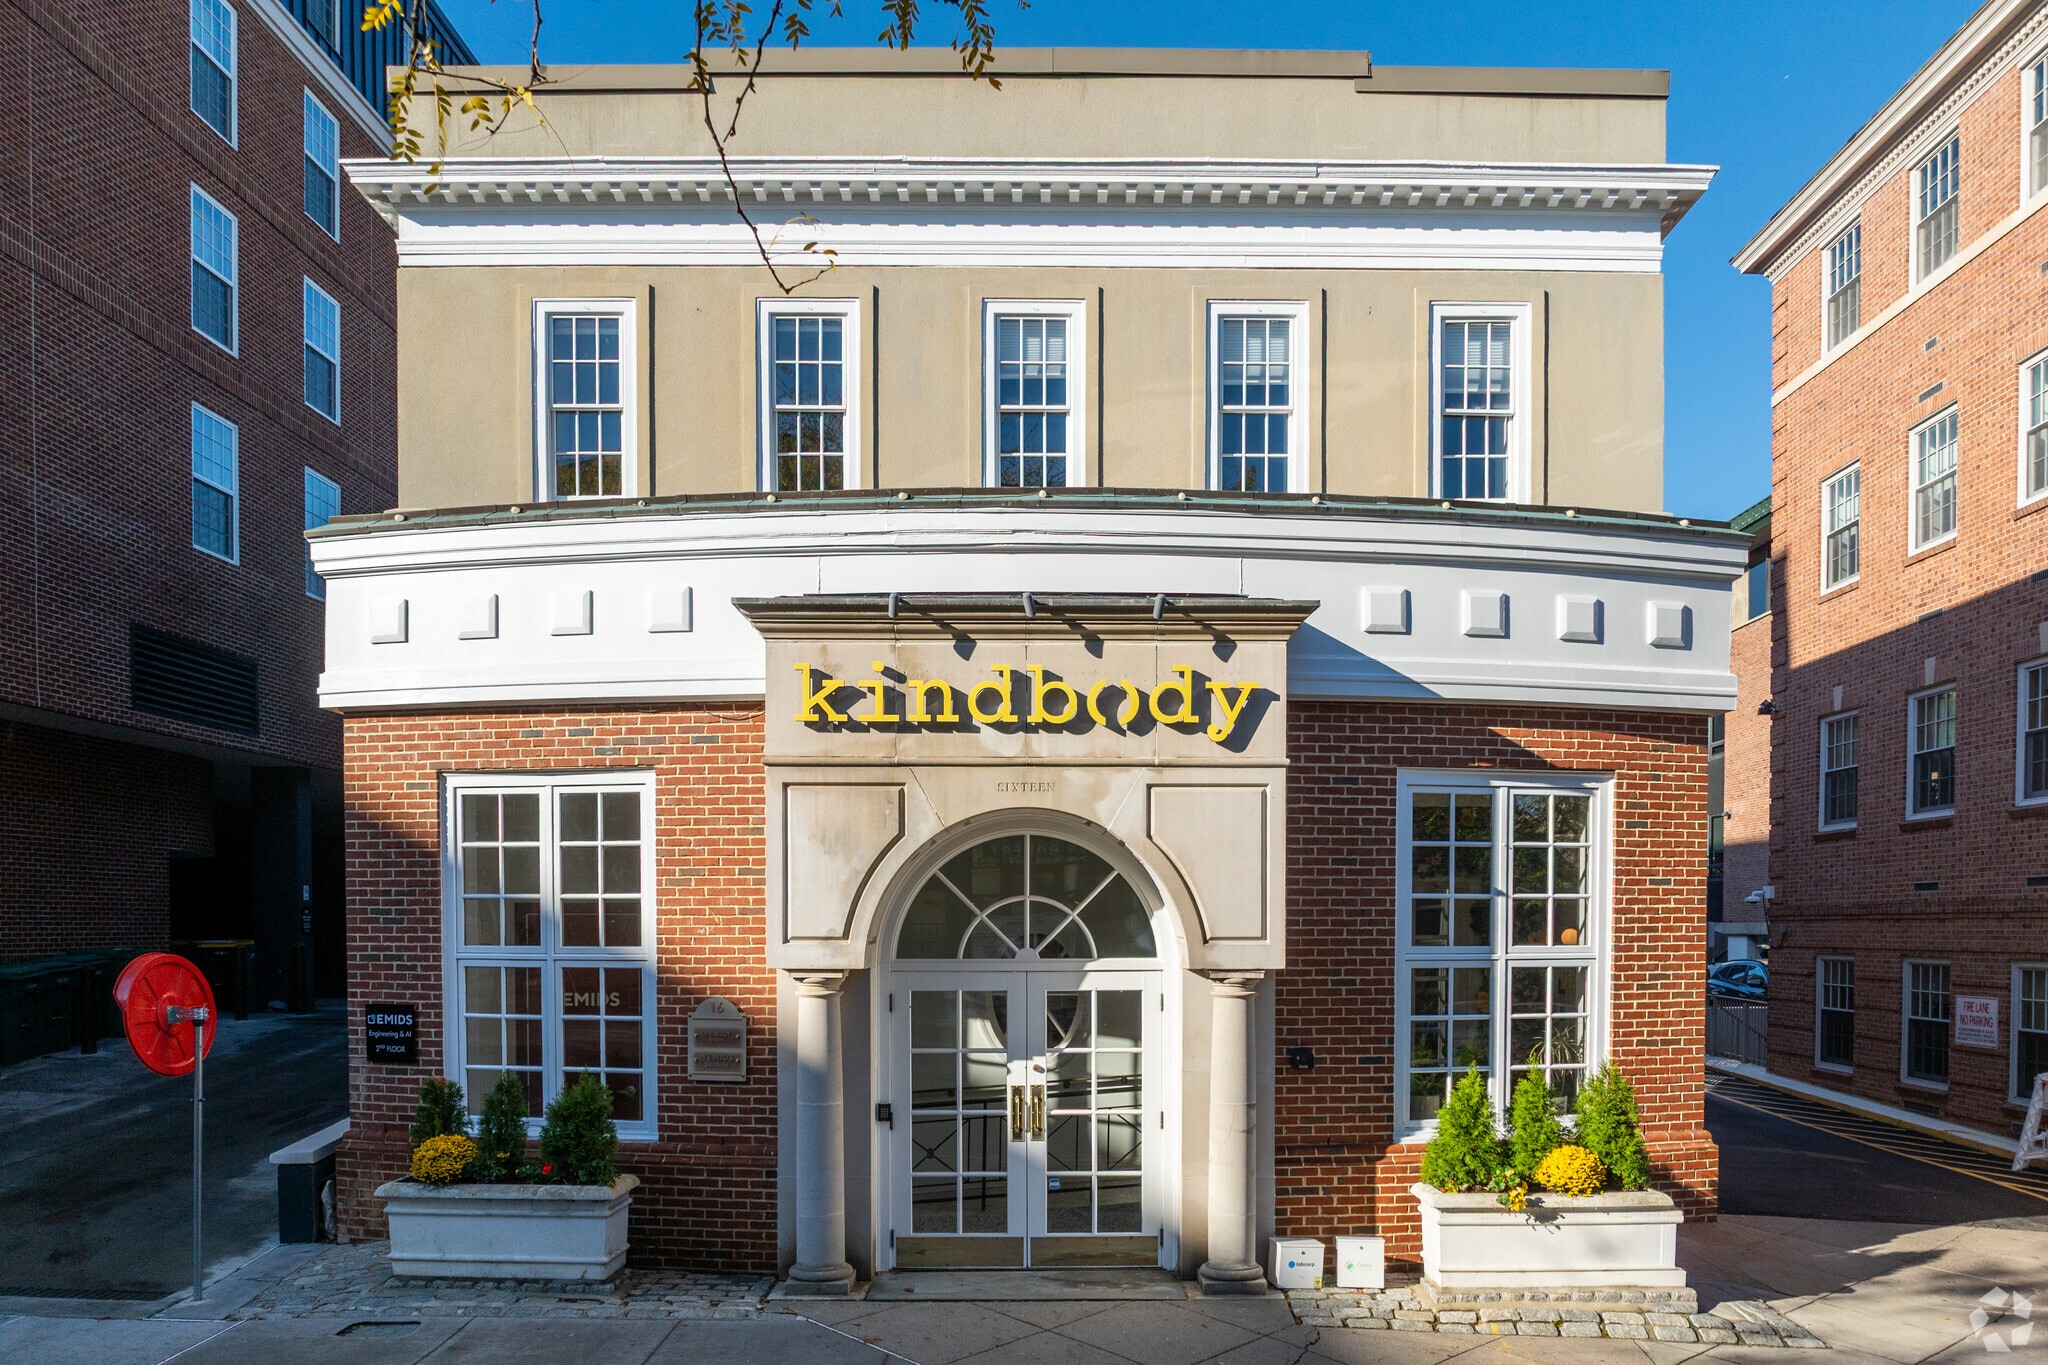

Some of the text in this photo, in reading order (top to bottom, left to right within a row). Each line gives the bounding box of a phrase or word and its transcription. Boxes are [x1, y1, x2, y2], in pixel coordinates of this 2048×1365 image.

[794, 661, 1260, 742] kindbody
[997, 782, 1056, 792] SIXTEEN
[710, 1001, 725, 1013] 16
[1963, 1001, 1990, 1014] FIRE LANE
[376, 1014, 413, 1025] EMIDS
[1960, 1014, 1993, 1028] NO PARKING
[368, 1030, 398, 1039] Engineering
[386, 1045, 406, 1053] FLOOR
